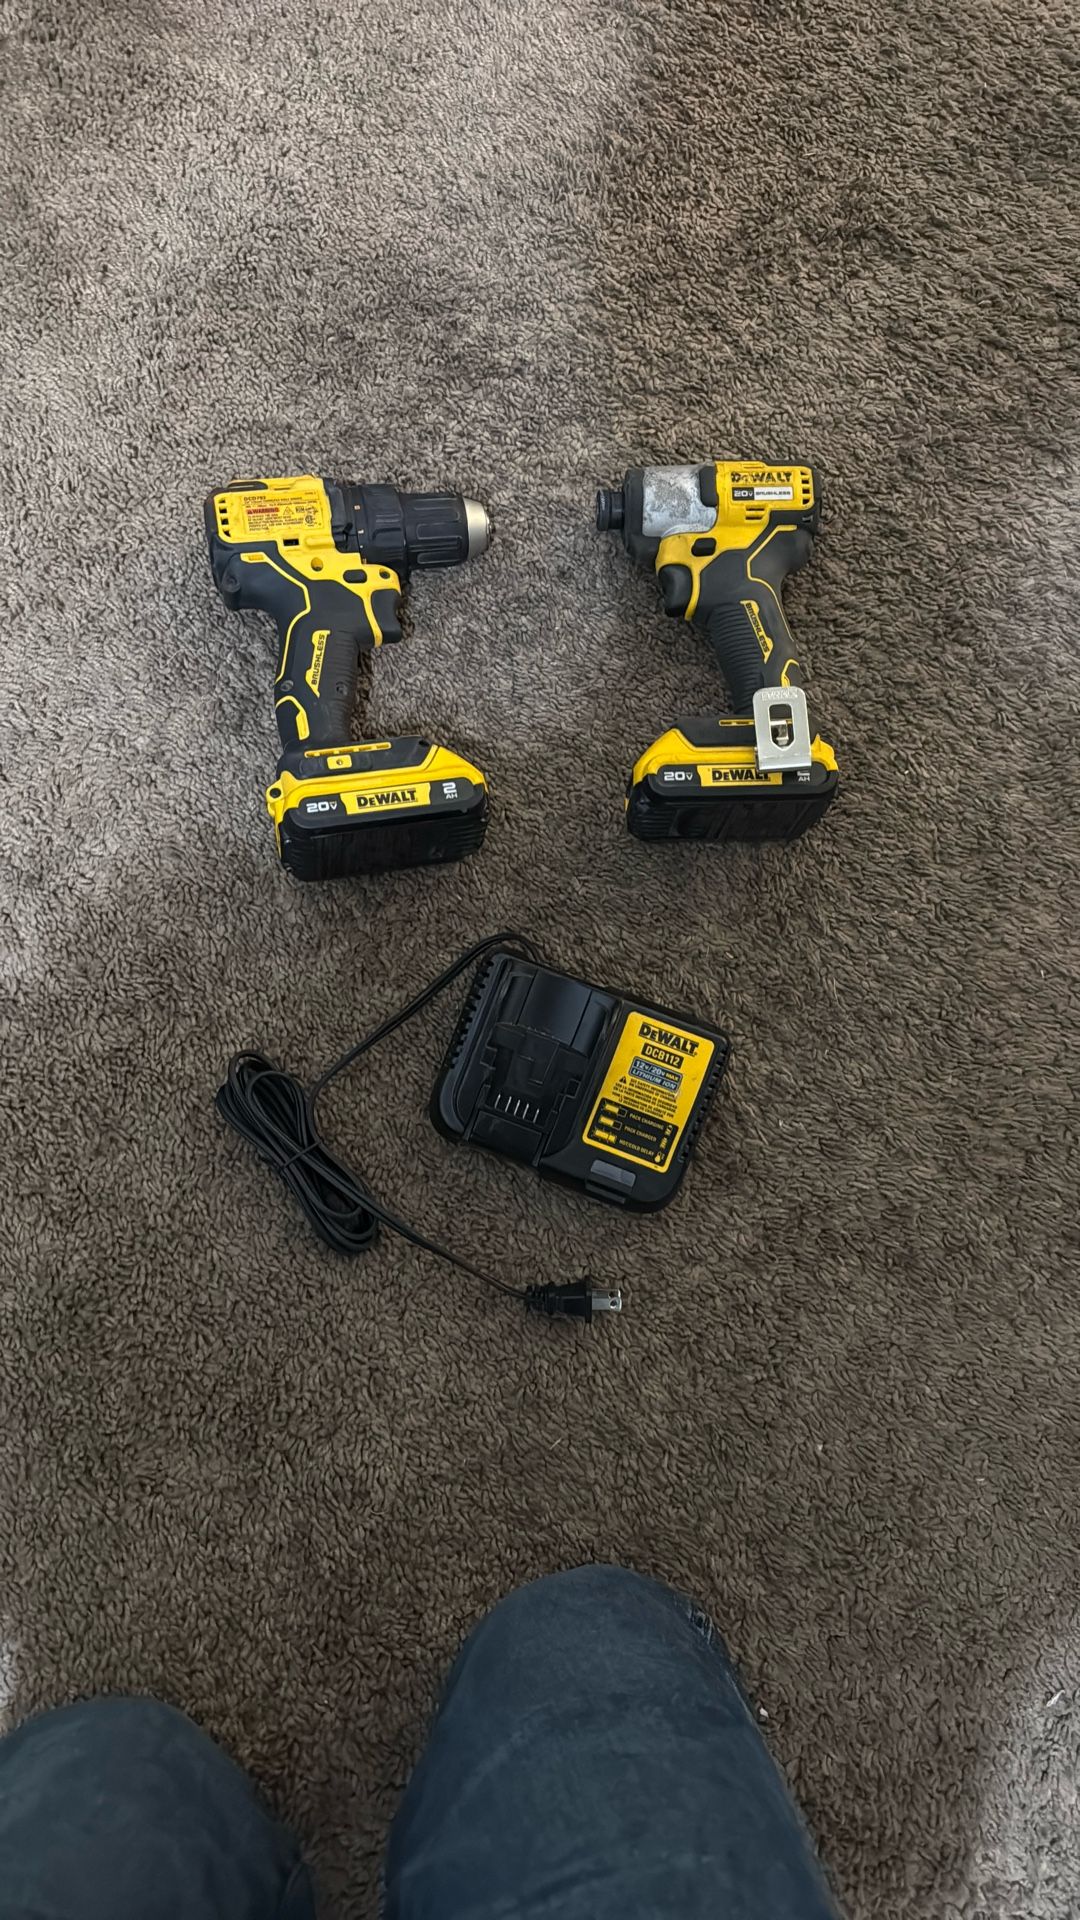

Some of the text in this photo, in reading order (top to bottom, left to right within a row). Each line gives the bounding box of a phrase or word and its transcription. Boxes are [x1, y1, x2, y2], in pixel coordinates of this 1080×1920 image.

[745, 602, 770, 653] BRUSHLESS
[311, 633, 325, 686] BRUSHLESS
[664, 771, 693, 781] 20V
[306, 782, 456, 814] 20V DEWALT 2
[639, 1022, 699, 1056] DEWALT
[645, 1045, 680, 1066] DCB112
[632, 1069, 677, 1090] LITHIUM ION
[665, 1072, 679, 1081] MAX
[629, 1113, 641, 1121] PACK
[624, 1126, 636, 1134] PACK
[640, 1146, 654, 1156] DELAY
